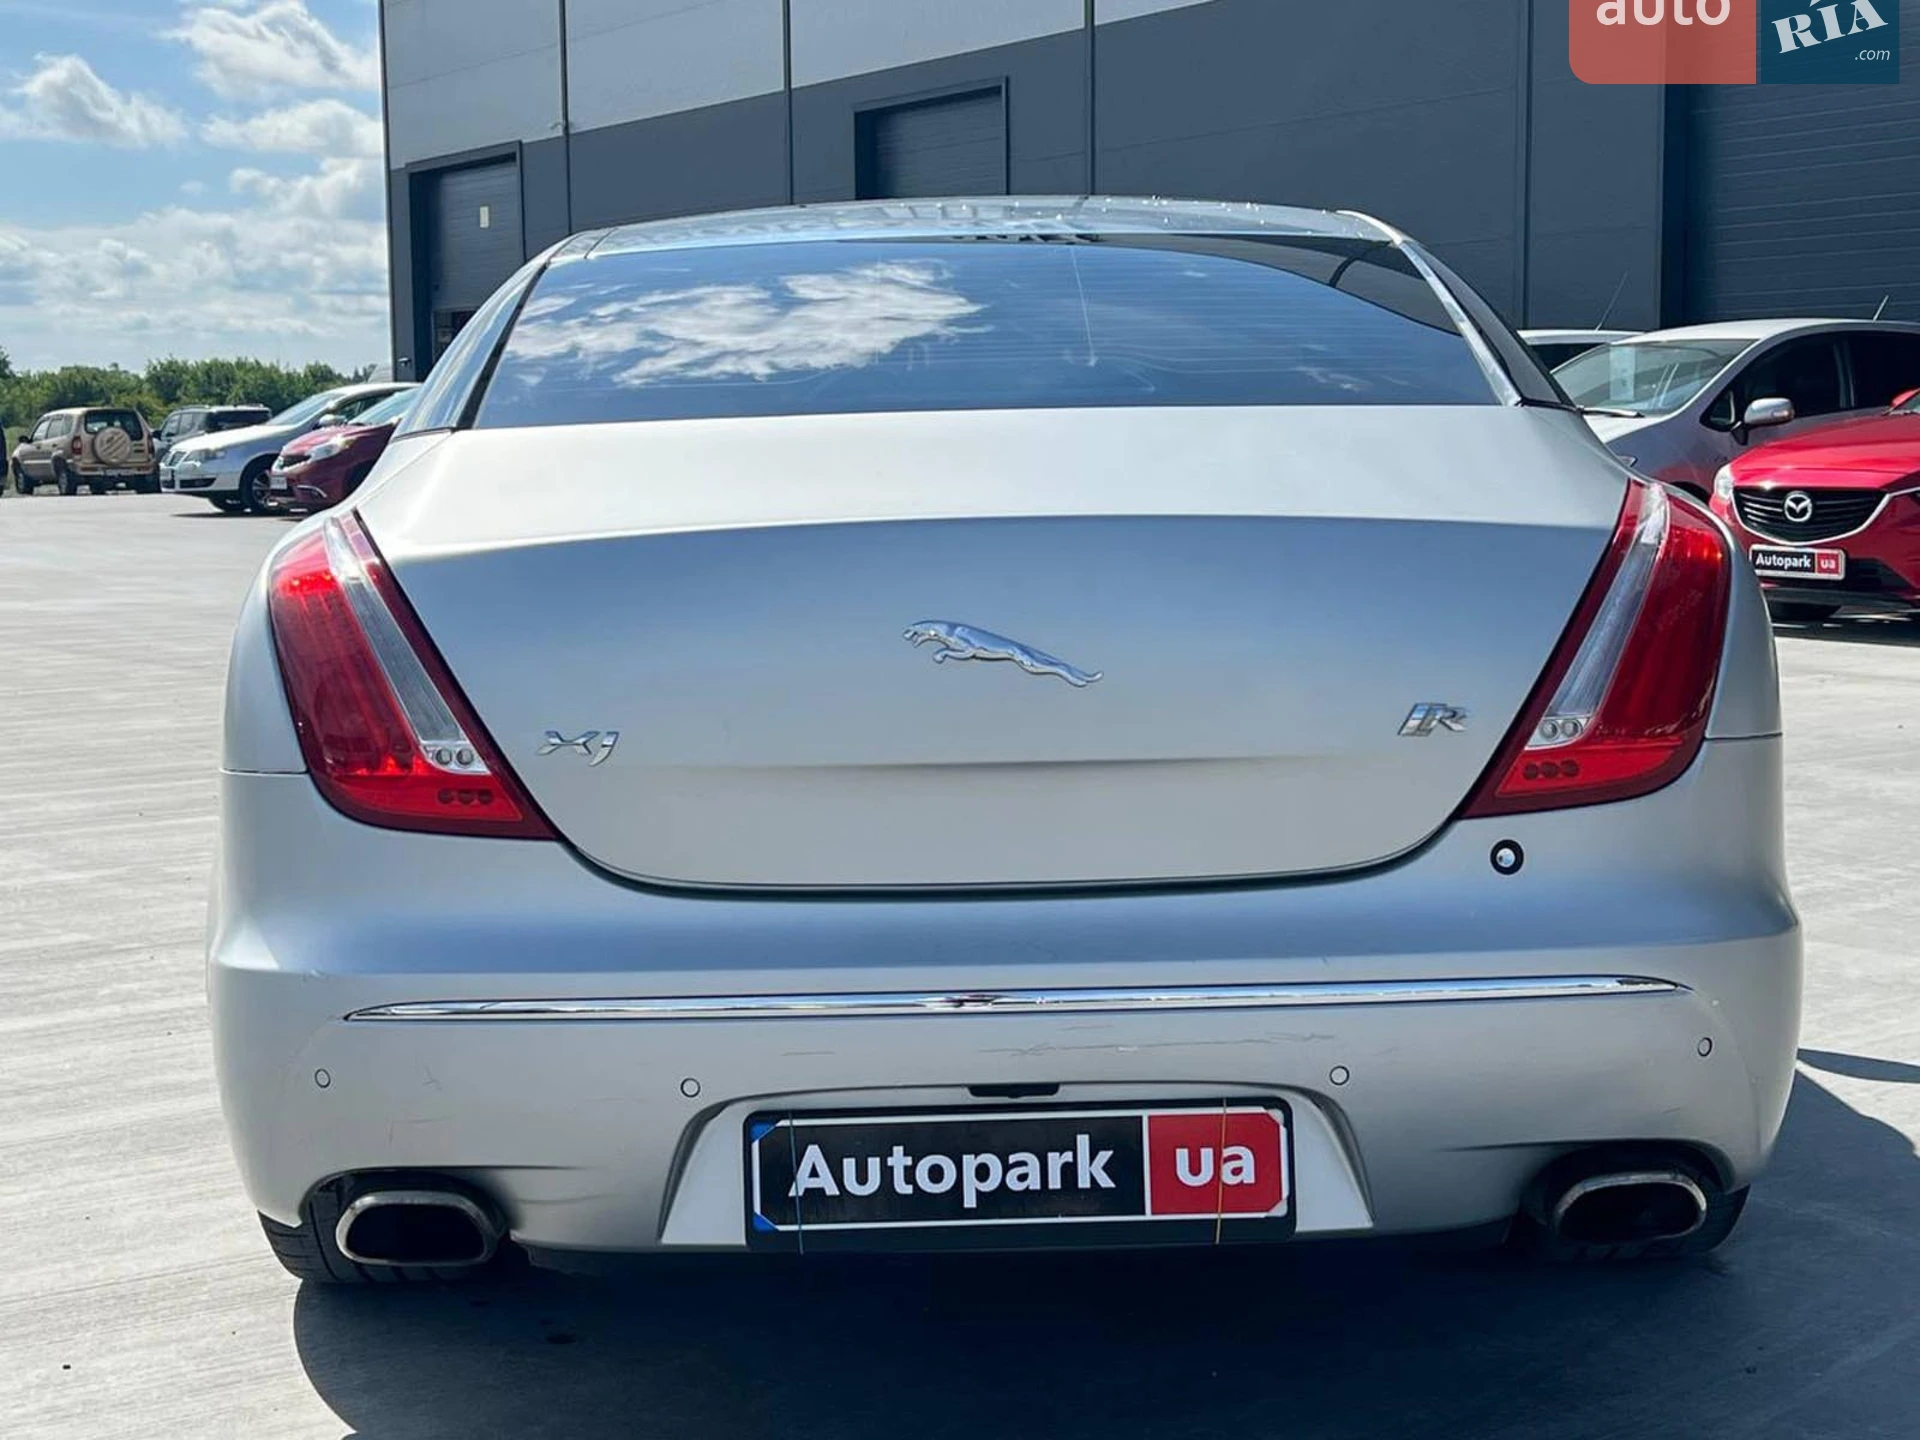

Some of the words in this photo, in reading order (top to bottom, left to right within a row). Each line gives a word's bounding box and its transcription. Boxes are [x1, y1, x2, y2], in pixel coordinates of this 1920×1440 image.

[1756, 552, 1811, 569] Autopark
[1820, 557, 1836, 569] ua
[537, 731, 619, 767] XJ
[788, 1134, 1116, 1208] Autopark
[1174, 1143, 1257, 1187] ua
